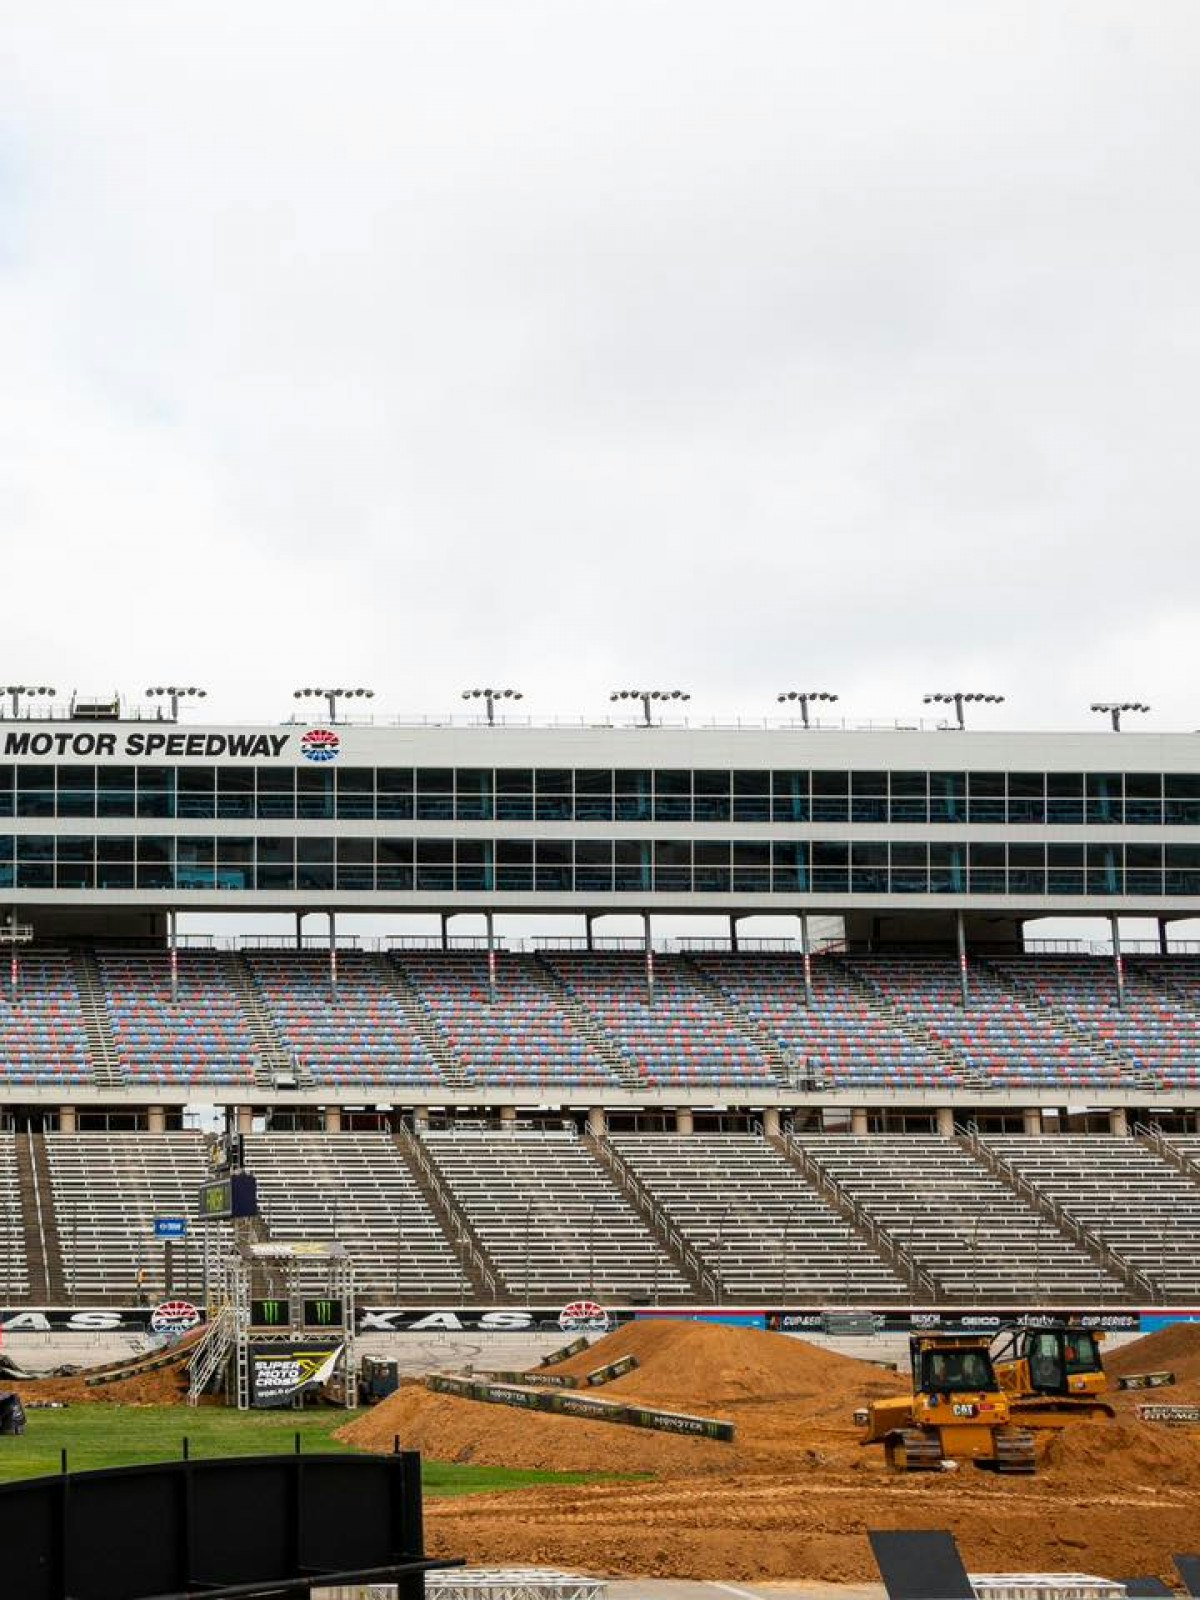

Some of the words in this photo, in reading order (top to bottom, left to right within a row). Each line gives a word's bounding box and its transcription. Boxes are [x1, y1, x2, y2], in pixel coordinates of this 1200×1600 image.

[4, 732, 117, 756] MOTOR
[125, 733, 291, 757] SPEEDWAY
[912, 1315, 941, 1325] BUSCH
[961, 1316, 1000, 1326] GEICO
[1017, 1314, 1055, 1326] xfinity
[1081, 1316, 1101, 1326] CUP
[1101, 1316, 1133, 1326] SERIES
[255, 1361, 299, 1370] SUPER
[258, 1369, 298, 1378] MOTO
[953, 1404, 973, 1416] CAT
